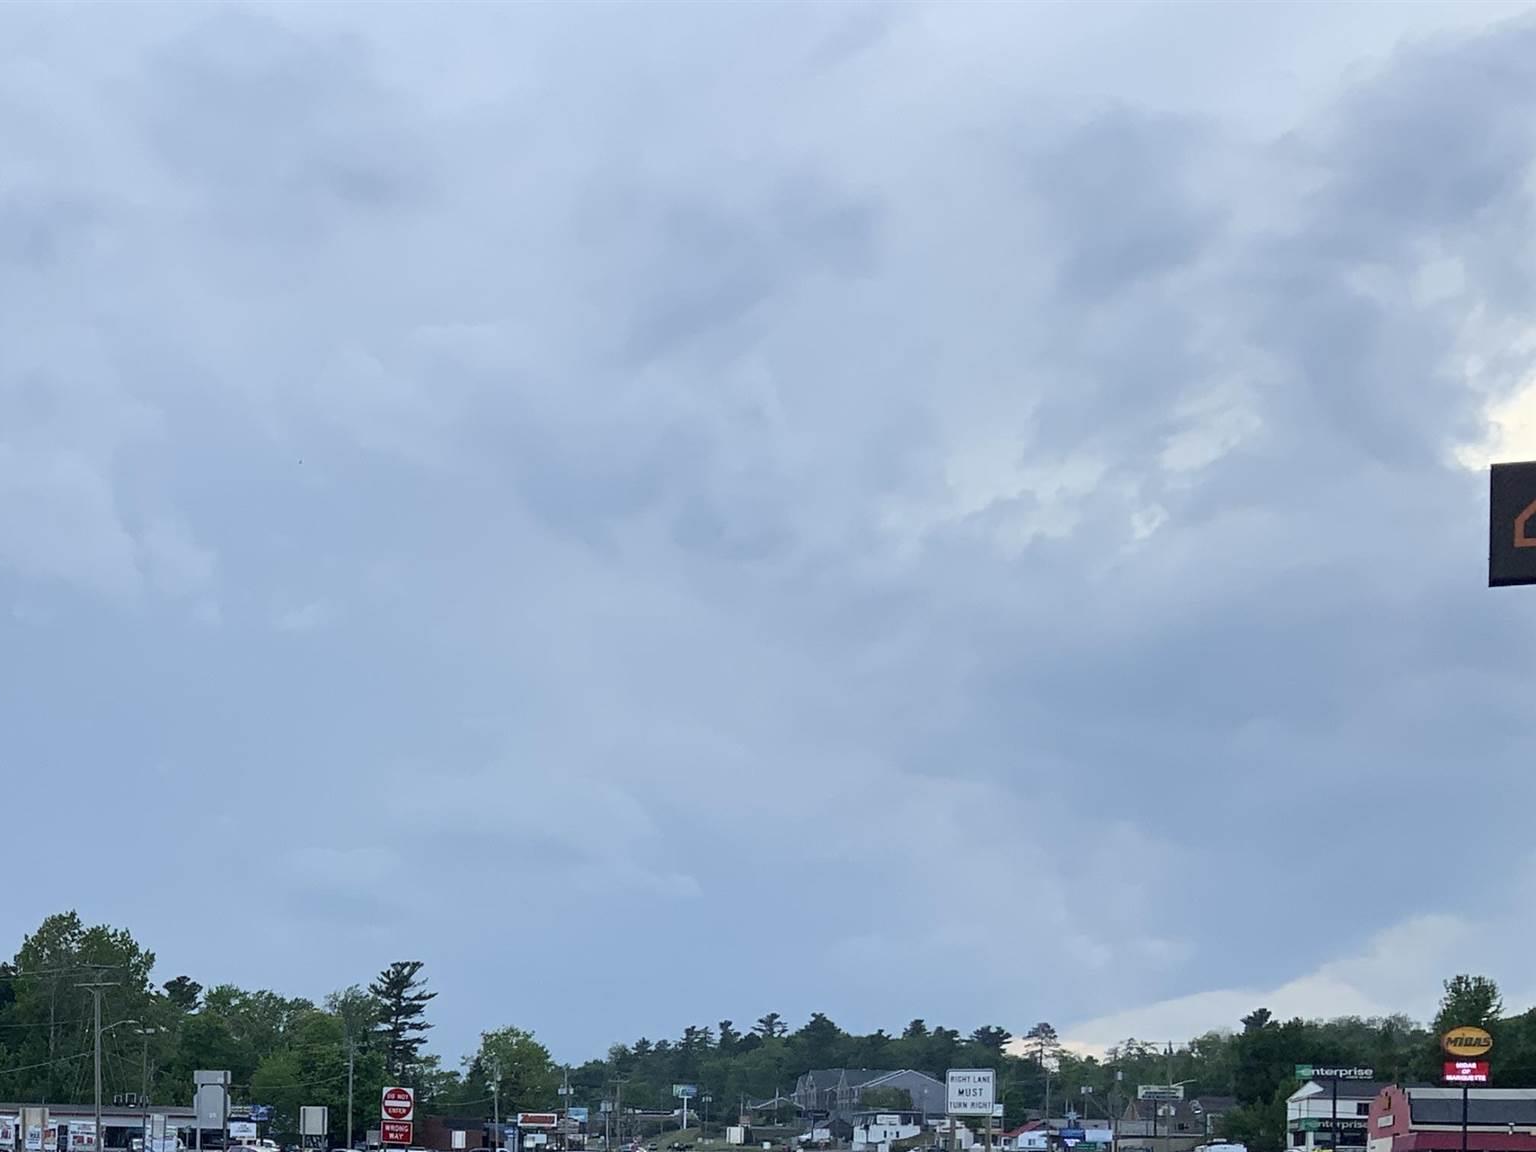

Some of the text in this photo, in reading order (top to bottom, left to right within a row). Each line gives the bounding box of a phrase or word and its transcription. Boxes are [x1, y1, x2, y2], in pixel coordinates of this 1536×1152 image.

[1446, 1033, 1490, 1048] MIDAS
[1297, 1067, 1374, 1078] enterprise
[958, 1088, 983, 1097] MUST
[384, 1124, 409, 1133] WRONG
[388, 1132, 404, 1140] WAY
